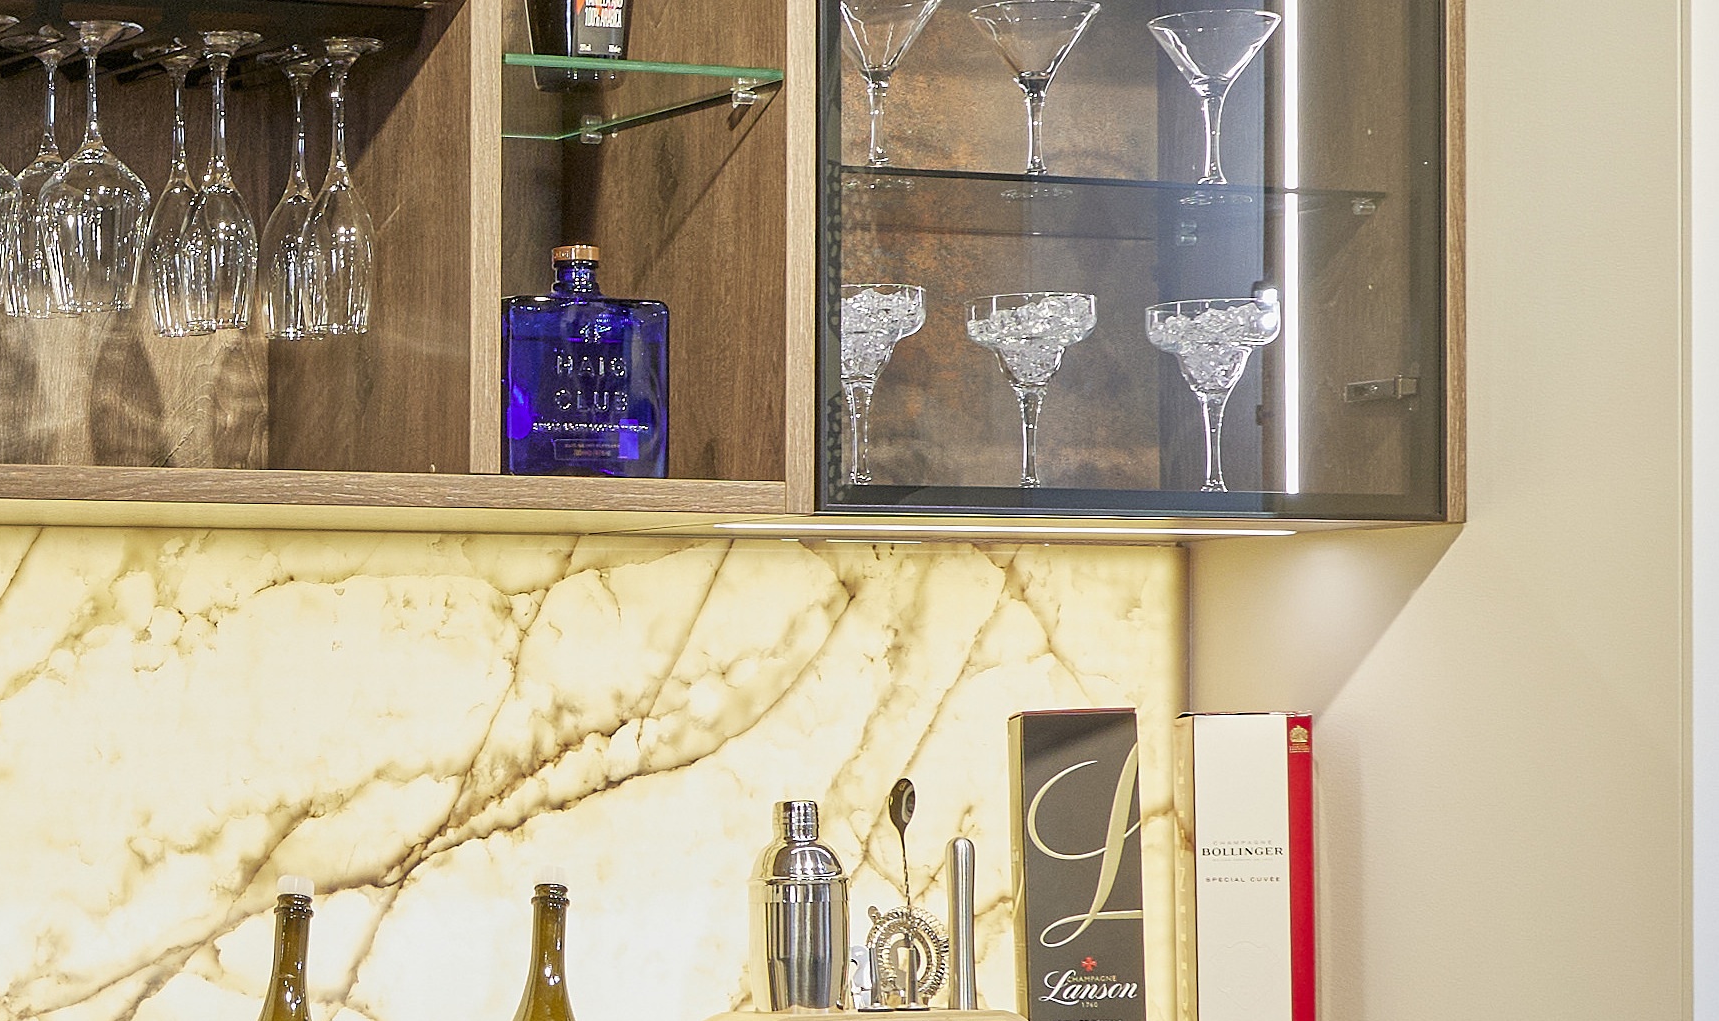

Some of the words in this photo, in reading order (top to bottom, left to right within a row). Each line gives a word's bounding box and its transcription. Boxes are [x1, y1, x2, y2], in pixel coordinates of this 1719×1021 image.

[555, 355, 628, 377] HAIG
[555, 389, 628, 412] CLUB
[1202, 847, 1284, 857] BOLLINGER
[1038, 969, 1138, 1006] Lanson
[1066, 975, 1117, 983] CHAMPAGNE
